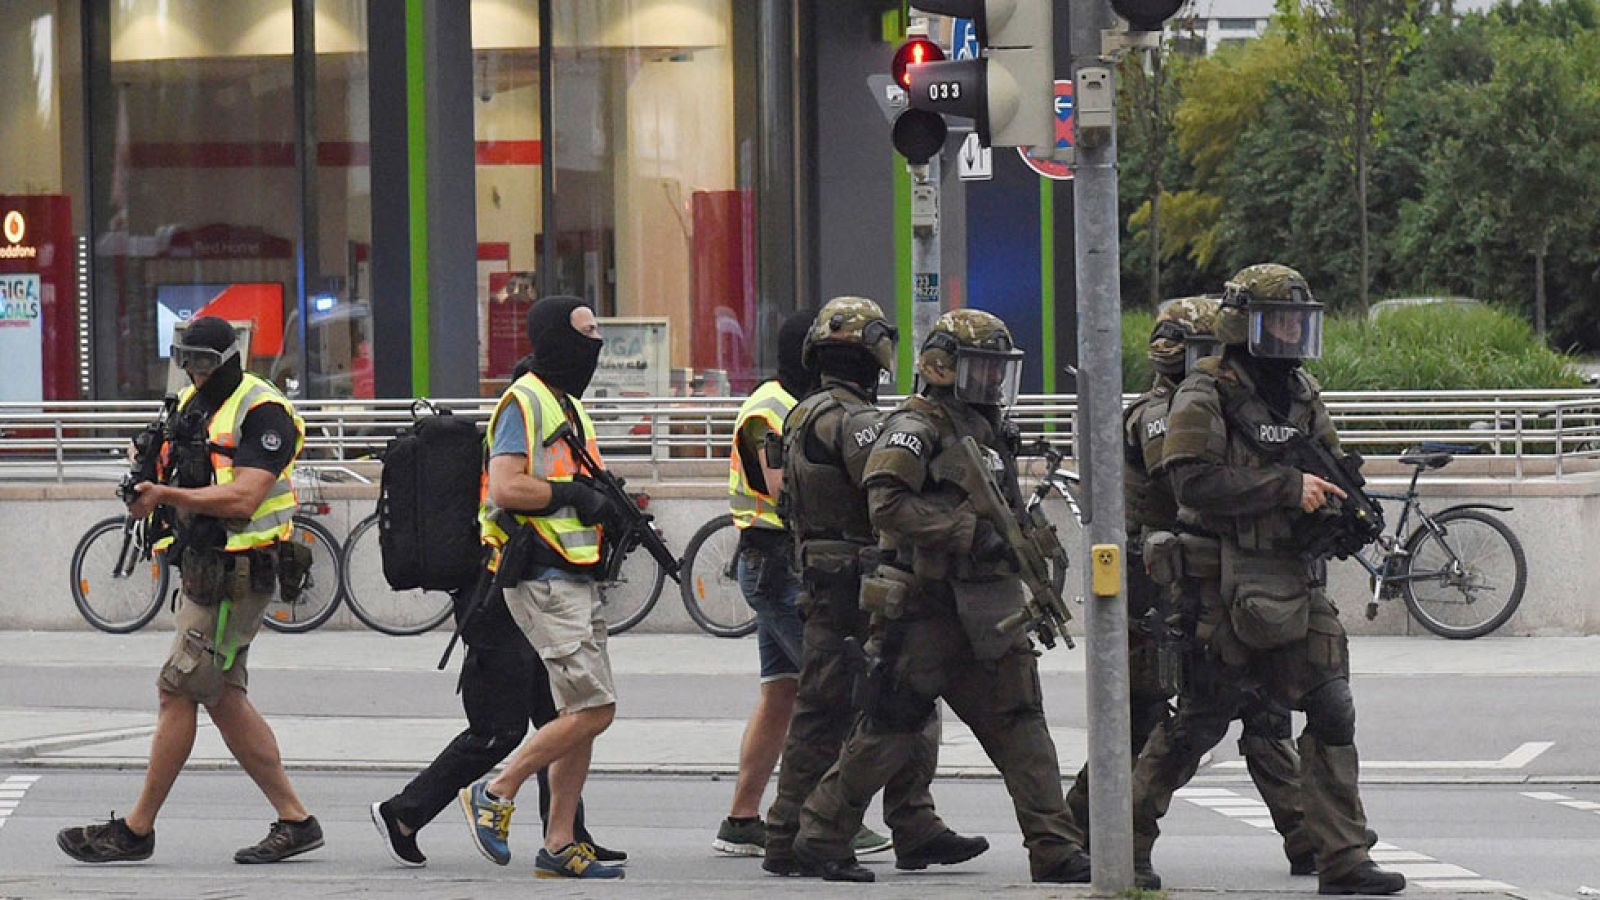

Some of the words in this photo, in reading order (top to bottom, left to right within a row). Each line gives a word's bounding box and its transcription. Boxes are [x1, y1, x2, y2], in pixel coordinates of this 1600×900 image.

[929, 83, 960, 99] 033
[0, 244, 37, 259] odafone
[478, 808, 494, 828] N
